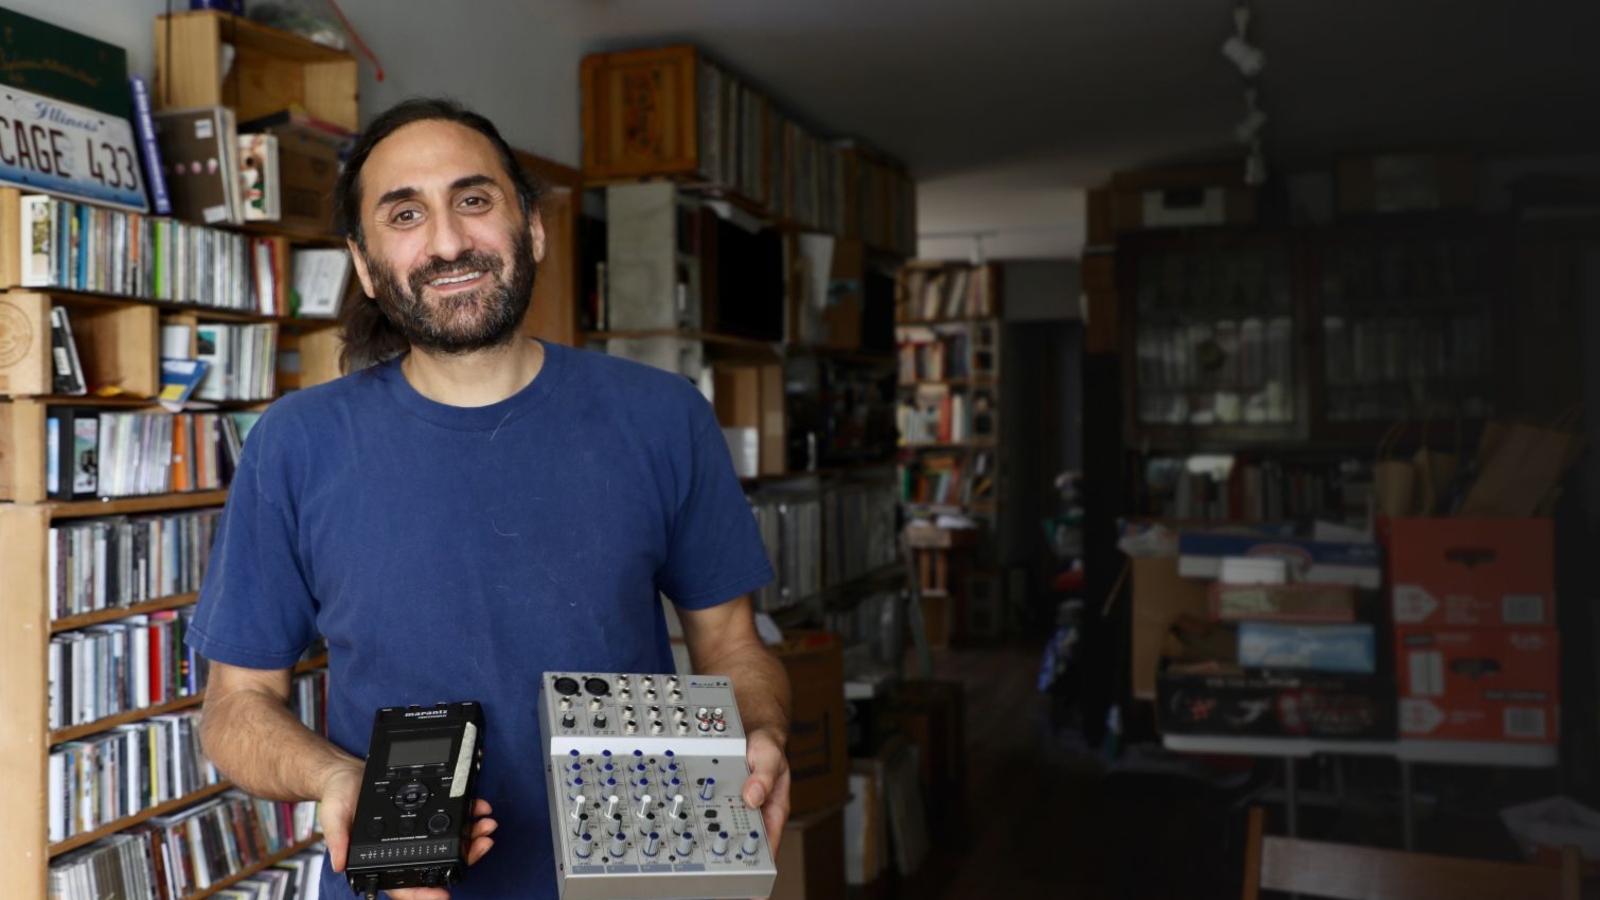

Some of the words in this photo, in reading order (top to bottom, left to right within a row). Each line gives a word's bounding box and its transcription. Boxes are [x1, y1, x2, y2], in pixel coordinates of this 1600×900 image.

[34, 100, 99, 132] Illinois
[0, 115, 71, 178] CAGE
[86, 137, 138, 191] 433
[404, 709, 448, 717] marantz
